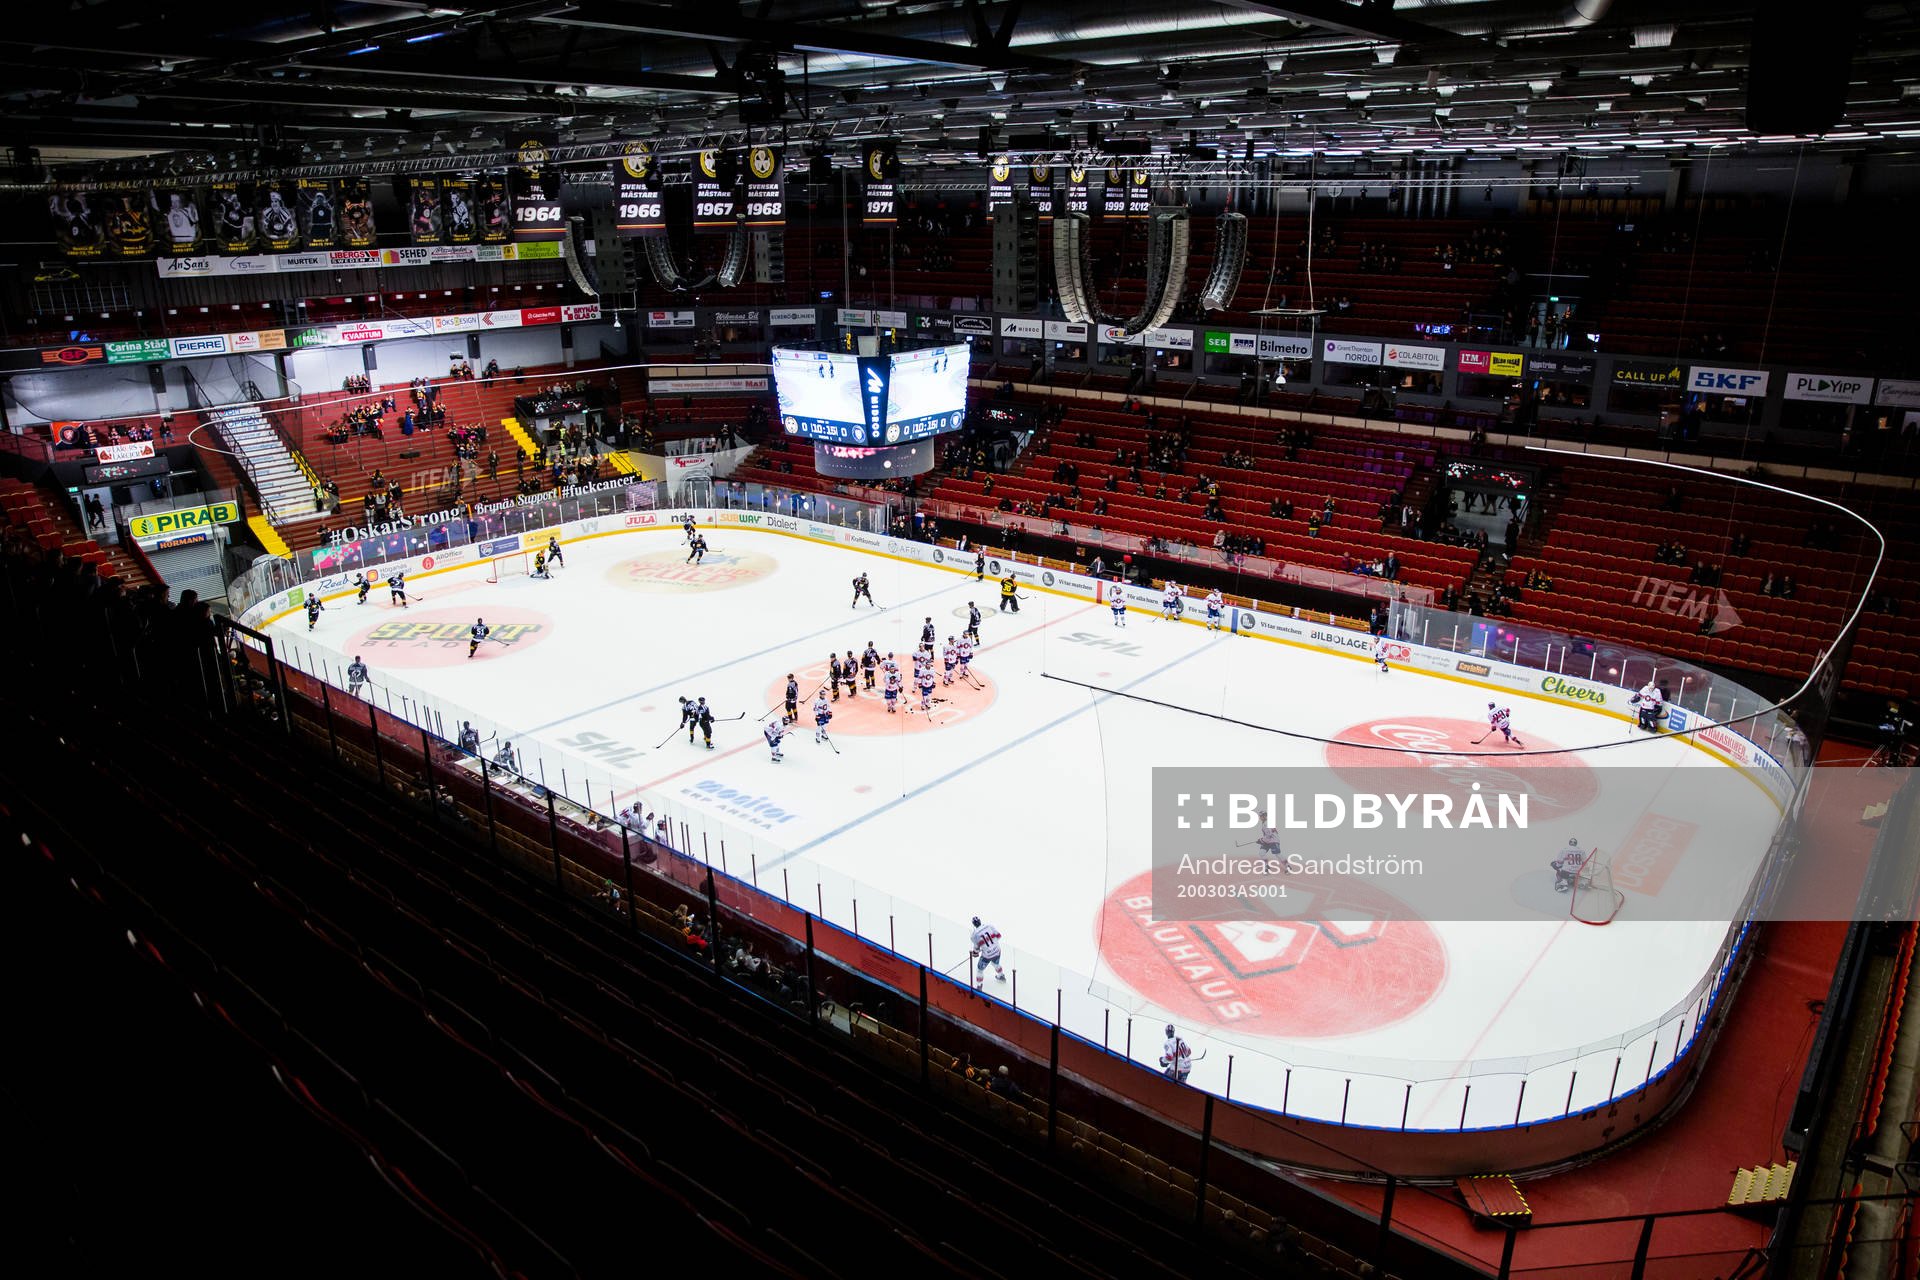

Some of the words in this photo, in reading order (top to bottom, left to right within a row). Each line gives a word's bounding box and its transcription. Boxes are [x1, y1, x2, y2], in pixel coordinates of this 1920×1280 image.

[619, 204, 661, 218] 1966
[696, 203, 734, 216] 1967
[747, 203, 782, 216] 1968
[867, 201, 894, 213] 1971
[1038, 201, 1052, 212] 80
[1104, 201, 1125, 211] 1999
[1129, 201, 1149, 211] 2012
[516, 206, 561, 222] 1964
[330, 250, 366, 259] LIBERGS
[400, 249, 428, 259] SEHED
[287, 258, 319, 266] MURTEK
[344, 330, 382, 341] KVANTUM
[110, 342, 142, 352] Carina
[178, 340, 223, 351] PIERRE
[1208, 338, 1228, 347] SEB
[1260, 340, 1308, 354] Bilmetro
[1398, 351, 1441, 362] COLABITOIL
[1617, 370, 1646, 381] CALL
[1650, 372, 1667, 382] UP
[1695, 372, 1761, 390] SKF
[801, 422, 808, 431] 0
[841, 427, 848, 437] 0
[329, 508, 462, 546] #OskarStrong
[474, 498, 515, 516] Brynäs
[517, 487, 558, 506] Support
[562, 475, 637, 499] #fuckcancer
[157, 506, 229, 532] PIRAB
[626, 515, 656, 525] JULA
[720, 514, 761, 524] SUBWAY
[767, 516, 799, 532] Dialect
[1631, 575, 1711, 624] ITEM
[1276, 624, 1302, 636] matchen
[1057, 631, 1145, 657] SHL
[1541, 676, 1607, 706] Cheers
[556, 731, 647, 769] SHL
[1123, 894, 1251, 1021] BAUHAUS
